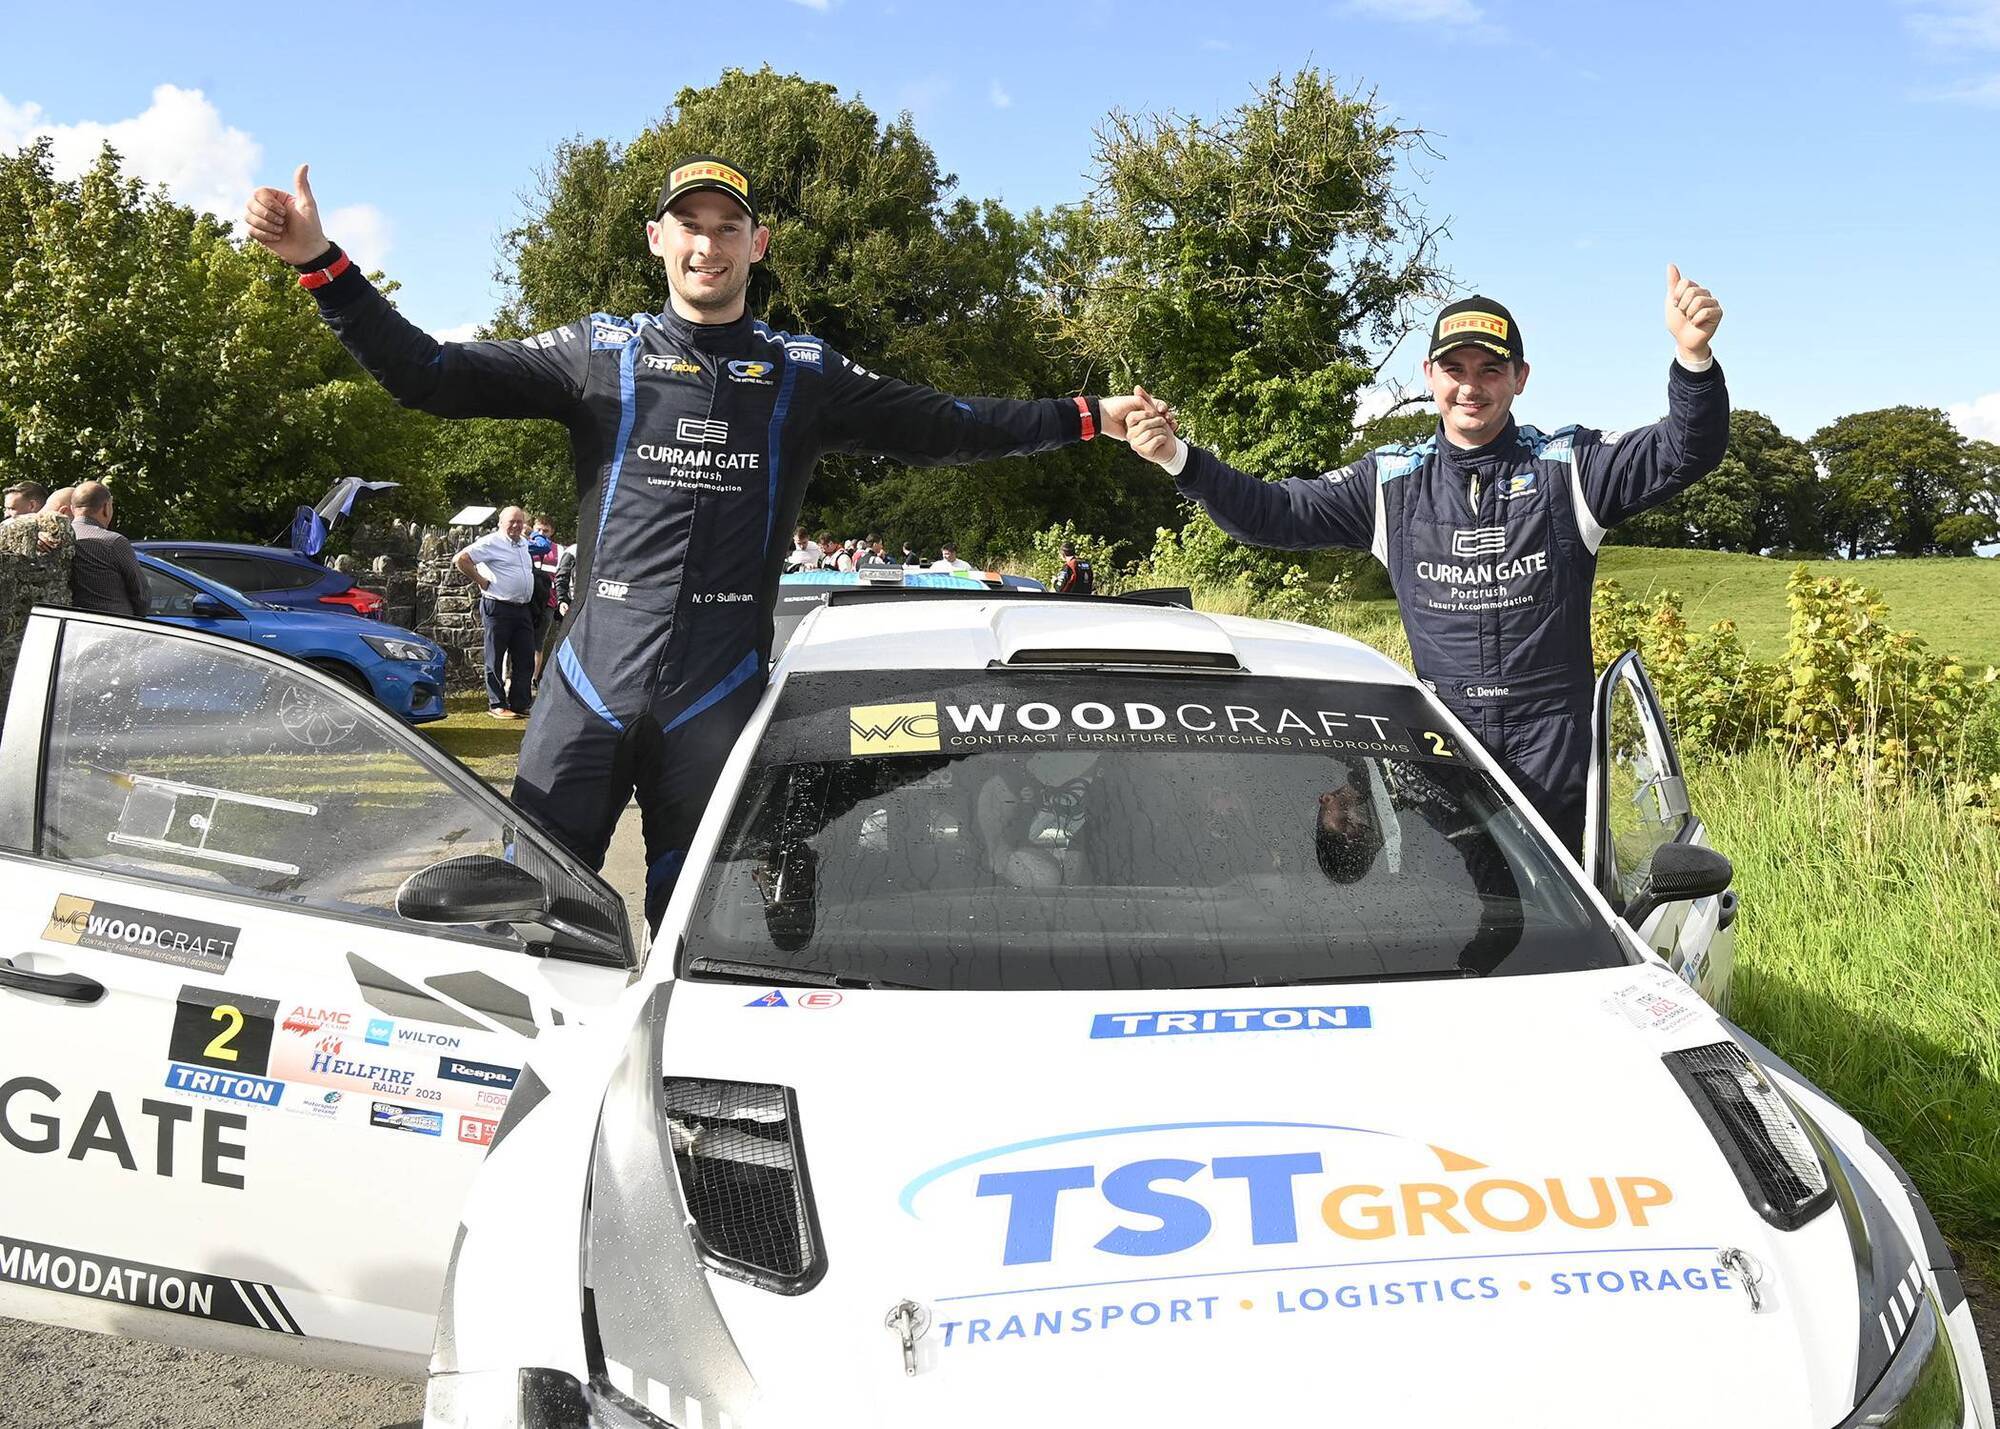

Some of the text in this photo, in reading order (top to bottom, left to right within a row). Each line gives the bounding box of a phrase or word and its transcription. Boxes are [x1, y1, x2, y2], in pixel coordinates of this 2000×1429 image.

[1443, 315, 1503, 334] PIRELLI
[594, 330, 629, 343] OMP
[788, 350, 820, 362] OMP
[637, 444, 760, 469] CURRAN GATE
[647, 477, 676, 488] Luxury
[670, 466, 722, 482] Portrush
[1416, 550, 1548, 584] CURRAN GATE
[598, 582, 629, 598] OMP
[1450, 585, 1508, 599] Portrush
[1428, 595, 1534, 611] Luxury Accommodation
[1466, 686, 1509, 697] C. Devine
[945, 702, 1390, 741] WOODCRAFT
[950, 732, 1410, 753] CONTRACT FURNITURE KITCHENS BEDROOMS
[1423, 731, 1453, 757] 2
[88, 915, 234, 960] WOODCRAFT
[80, 937, 115, 949] CONTRACT
[190, 958, 226, 972] BEDROOMS
[807, 994, 833, 1005] E
[290, 1006, 352, 1024] ALMC
[1111, 1008, 1349, 1035] TRITON
[203, 1004, 244, 1062] 2
[398, 1029, 461, 1048] WILTON
[311, 1053, 415, 1085] HELLFIRE
[176, 1069, 274, 1102] TRITON
[372, 1082, 442, 1101] RALLY 2023
[0, 1076, 248, 1190] GATE
[976, 1151, 1674, 1266] TST GROUP
[939, 1266, 1734, 1348] TRANSPORT LOGISTICS STORAGE
